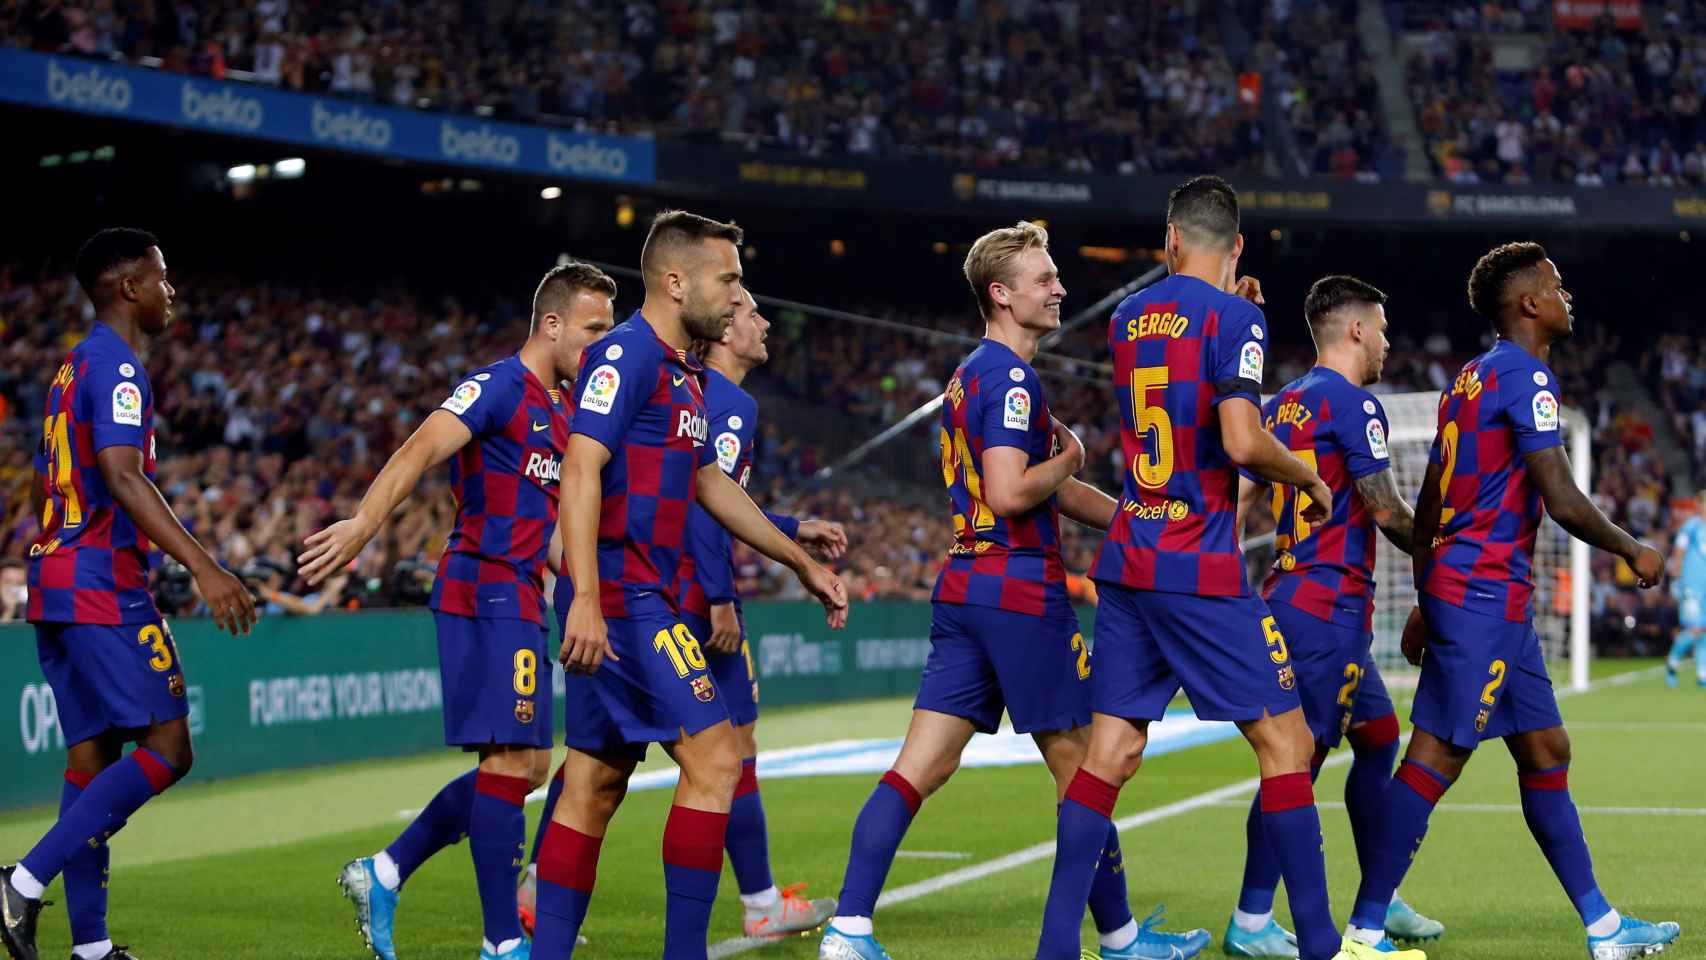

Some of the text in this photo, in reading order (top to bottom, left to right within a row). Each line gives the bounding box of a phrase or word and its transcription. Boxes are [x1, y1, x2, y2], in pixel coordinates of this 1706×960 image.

[47, 63, 131, 110] beko
[181, 86, 262, 130] beko
[312, 105, 391, 148] beko
[441, 123, 519, 164] beko
[547, 134, 628, 176] beko
[999, 180, 1091, 202] BARCELONA
[1477, 194, 1576, 216] BARCELONA
[1127, 312, 1189, 342] SERGIO
[583, 394, 609, 409] LaLiga
[1007, 416, 1028, 426] LaLiga
[1277, 398, 1312, 431] PÉREZ
[1130, 366, 1174, 489] 5
[1123, 498, 1169, 520] unicef
[138, 624, 177, 672] 3
[653, 623, 706, 679] 18
[1261, 616, 1289, 664] 5
[513, 648, 536, 695] 8
[1480, 659, 1506, 705] 2
[249, 676, 332, 726] FURTHER
[334, 672, 384, 718] YOUR
